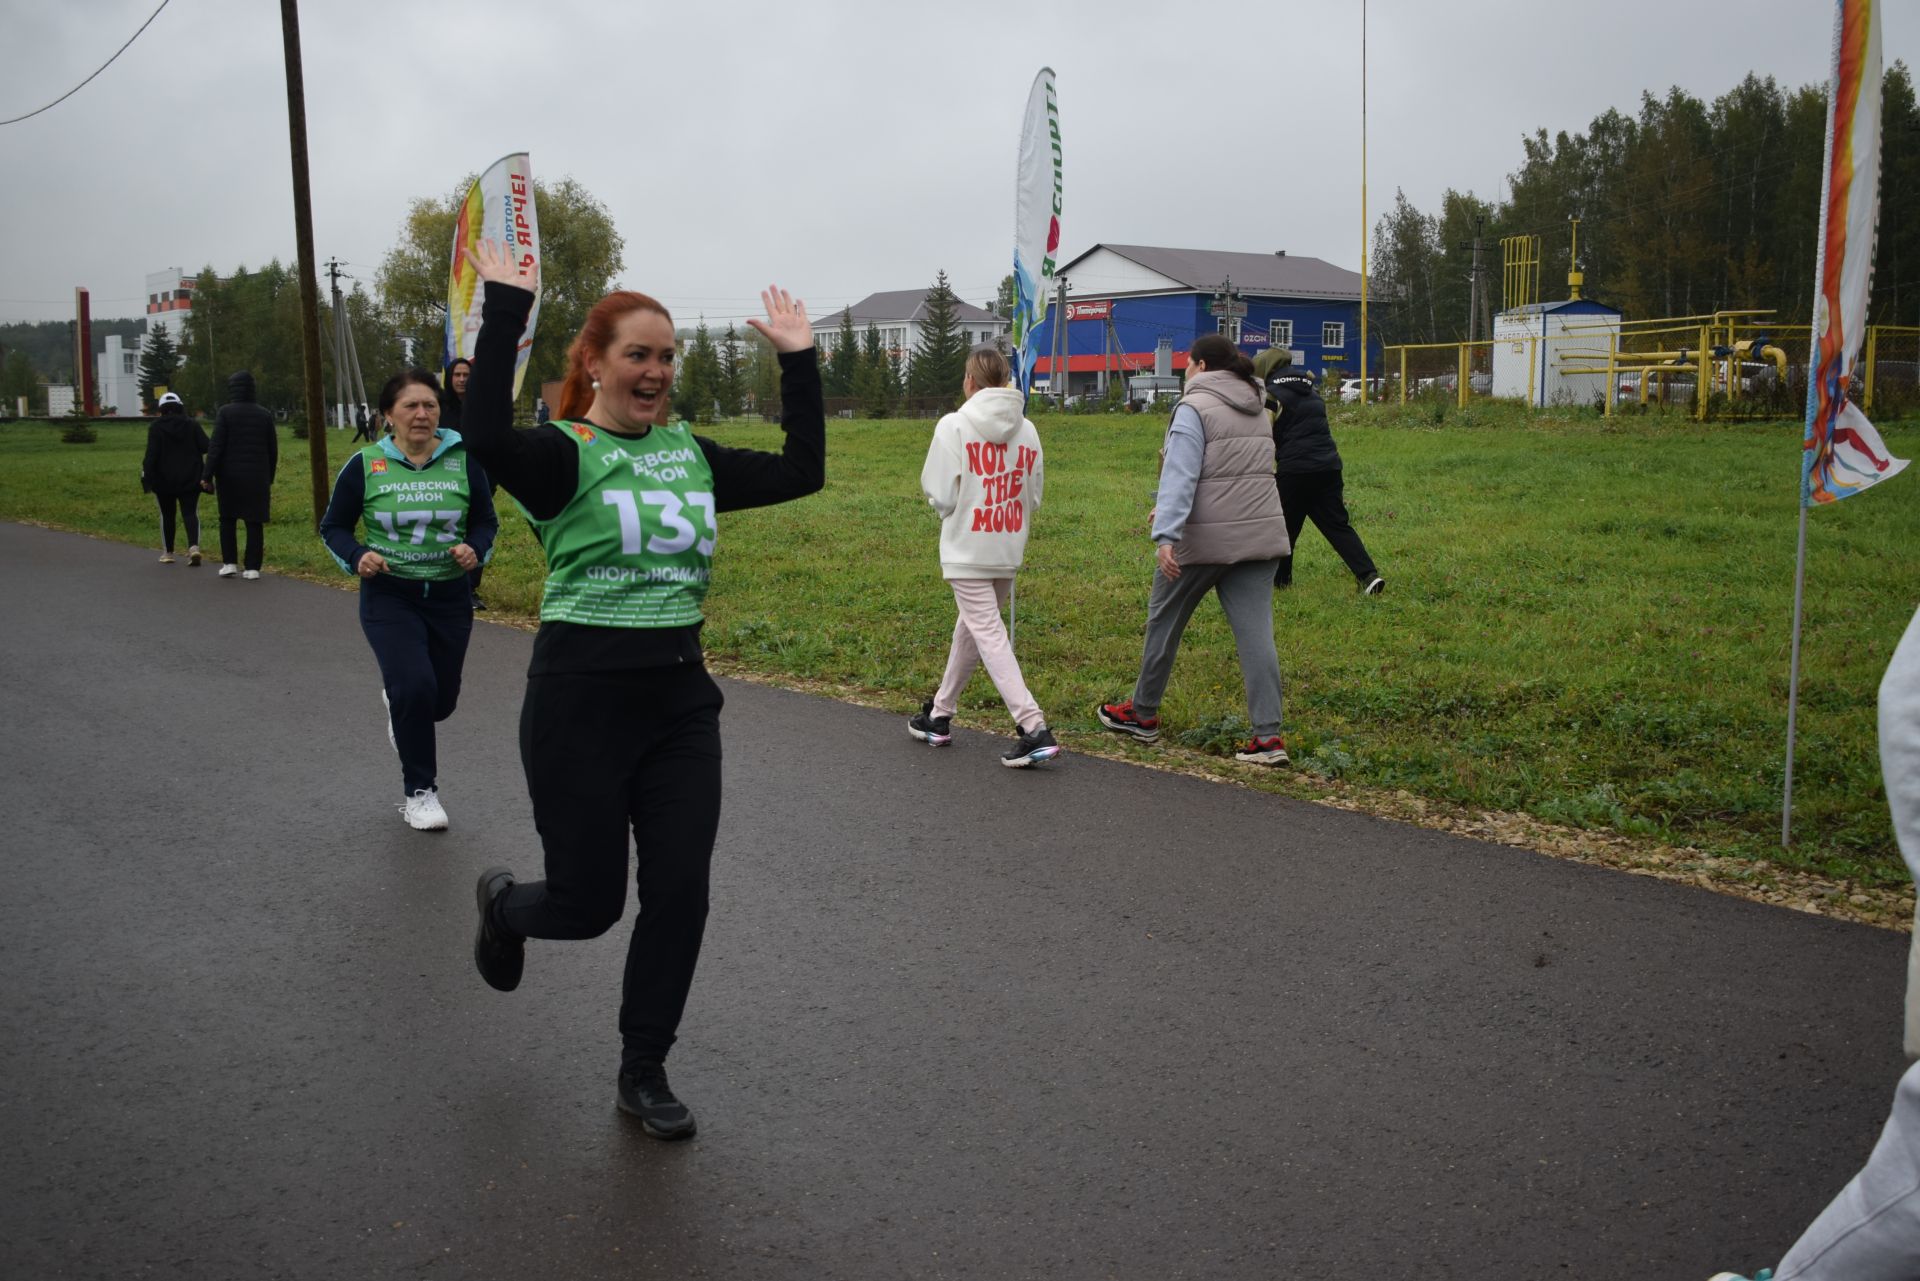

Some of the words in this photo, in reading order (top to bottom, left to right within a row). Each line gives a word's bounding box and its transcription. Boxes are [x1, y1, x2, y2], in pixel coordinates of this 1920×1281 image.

[504, 195, 515, 258] ОРТОМ
[511, 174, 532, 247] ЯРЧЕ!
[1273, 376, 1312, 386] MONCER
[966, 441, 1008, 477] NOT
[1016, 445, 1037, 476] IN
[379, 480, 460, 494] ТУКАЕВСКИЙ
[397, 491, 443, 503] РАЙОН
[983, 470, 1024, 507] THE
[374, 509, 462, 545] 173
[602, 490, 718, 557] 133
[971, 500, 1023, 533] MOOD
[586, 566, 639, 582] СПОРТ
